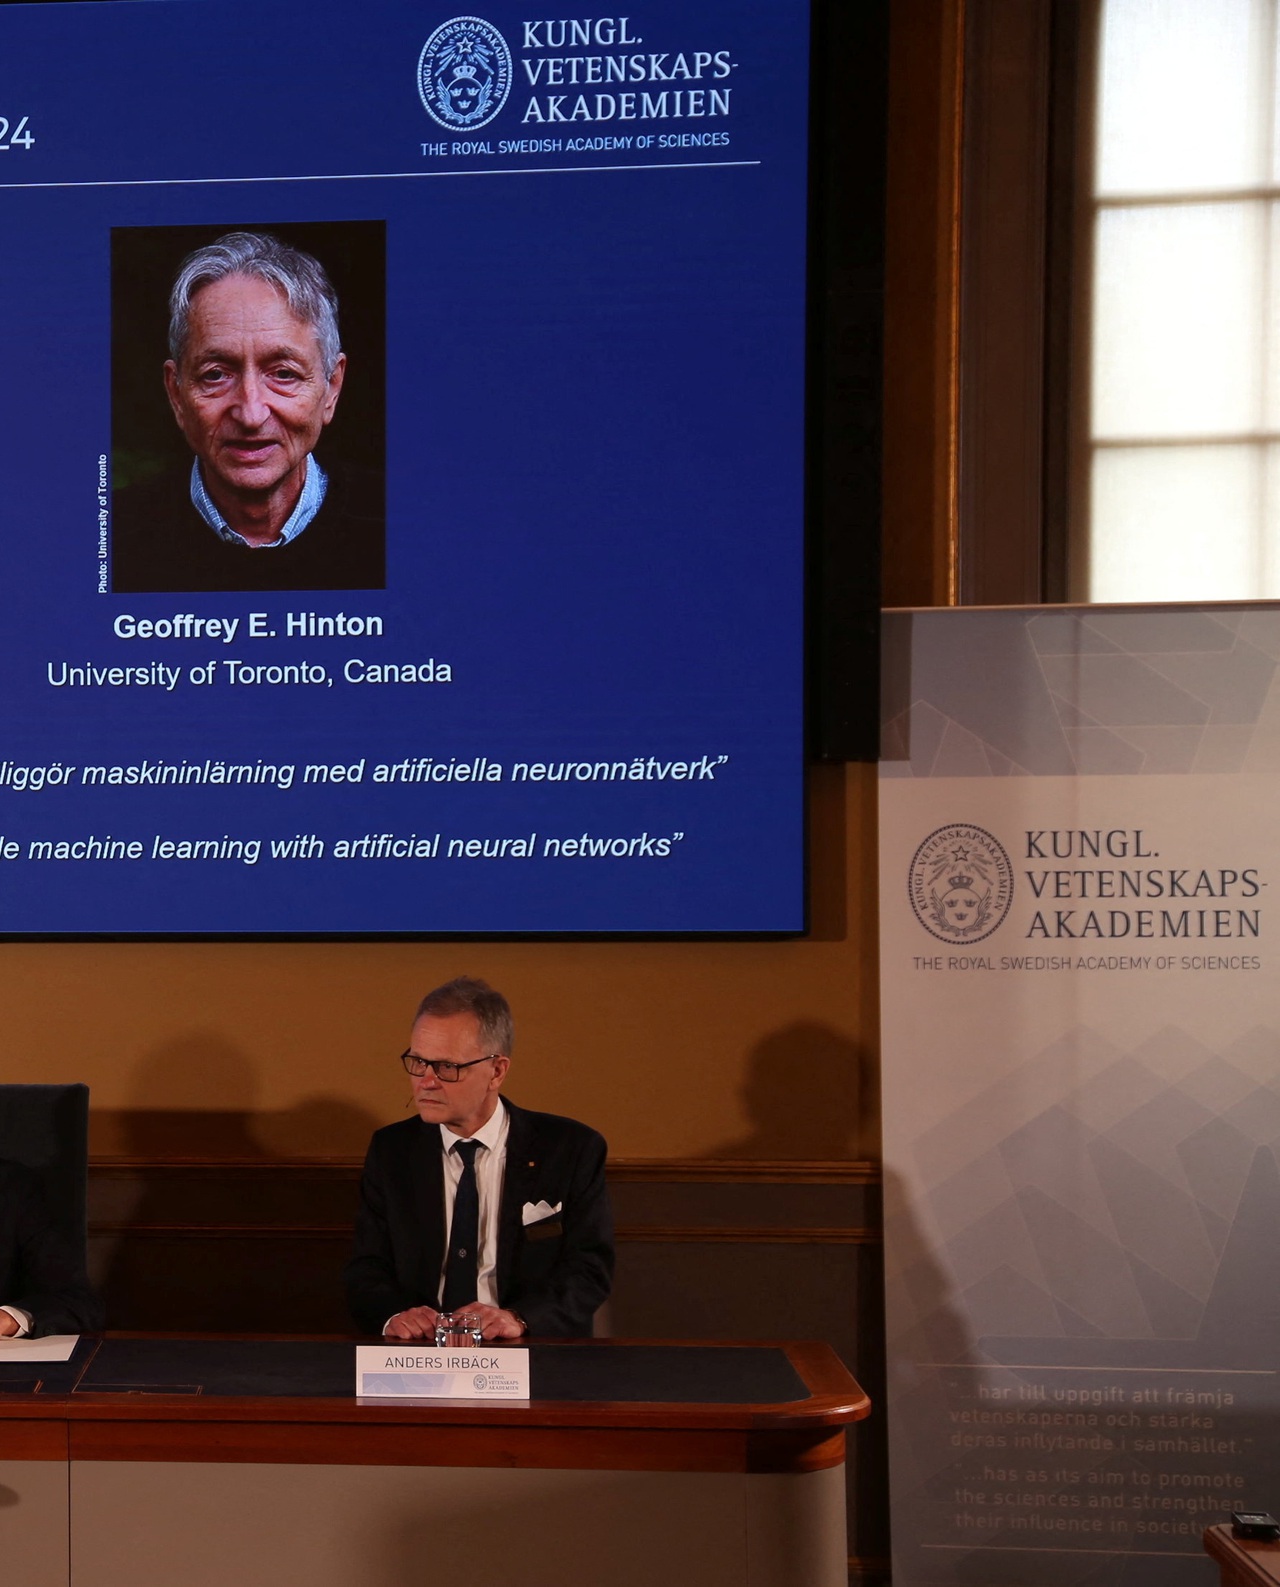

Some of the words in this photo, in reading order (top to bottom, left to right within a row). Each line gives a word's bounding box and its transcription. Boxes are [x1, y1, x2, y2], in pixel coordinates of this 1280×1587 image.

[523, 18, 642, 48] KUNGL.
[522, 51, 738, 85] VETENSKAPS-
[522, 89, 731, 123] AKADEMIEN
[421, 143, 447, 155] THE
[452, 142, 495, 154] ROYAL
[499, 139, 561, 153] SWEDISH
[566, 137, 633, 151] ACADEMY
[636, 135, 655, 148] OF
[659, 132, 729, 147] SCIENCES
[97, 454, 107, 494] Toronto
[98, 495, 107, 506] of
[98, 508, 109, 559] University
[98, 560, 108, 594] Photo:
[114, 614, 239, 643] Geoffrey
[250, 613, 275, 636] E.
[287, 612, 382, 636] Hinton
[48, 662, 180, 690] University
[190, 661, 216, 684] of
[223, 661, 332, 687] Toronto,
[344, 658, 451, 682] Canada
[82, 760, 294, 788] maskininlärning
[304, 759, 365, 782] med
[373, 758, 502, 782] artificiella
[29, 836, 142, 859] machine
[152, 835, 261, 864] learning
[271, 835, 324, 858] with
[334, 834, 440, 857] artificial
[448, 833, 536, 857] neural
[1025, 830, 1159, 858] KUNGL.
[1025, 870, 1267, 898] VETENSKAPS-
[1025, 910, 1259, 938] AKADEMIEN
[913, 957, 942, 970] THE
[948, 957, 996, 970] ROYAL
[1000, 957, 1071, 970] SWEDISH
[1075, 957, 1151, 970] ACADEMY
[1155, 956, 1176, 969] OF
[1182, 956, 1260, 970] SCIENCES
[384, 1356, 443, 1369] ANDERS
[447, 1354, 500, 1369] IRBÄCK
[1018, 1384, 1047, 1401] till
[1052, 1386, 1126, 1407] uppgift
[1131, 1387, 1160, 1405] att
[1165, 1387, 1235, 1410] främja
[949, 1408, 1099, 1431] vetenskaperna
[1105, 1410, 1142, 1428] och
[1148, 1411, 1216, 1430] stärka
[950, 1430, 1008, 1449] deras
[1013, 1431, 1115, 1452] inflytande
[1025, 1467, 1049, 1484] as
[1055, 1466, 1081, 1485] its
[1086, 1467, 1125, 1485] aim
[1131, 1469, 1152, 1486] to
[1158, 1471, 1246, 1491] promote
[954, 1487, 986, 1505] the
[992, 1488, 1081, 1508] sciences
[1087, 1490, 1125, 1508] and
[1131, 1492, 1246, 1514] strengthen
[954, 1511, 1003, 1529] their
[1008, 1512, 1103, 1532] influence
[1109, 1514, 1130, 1533] in
